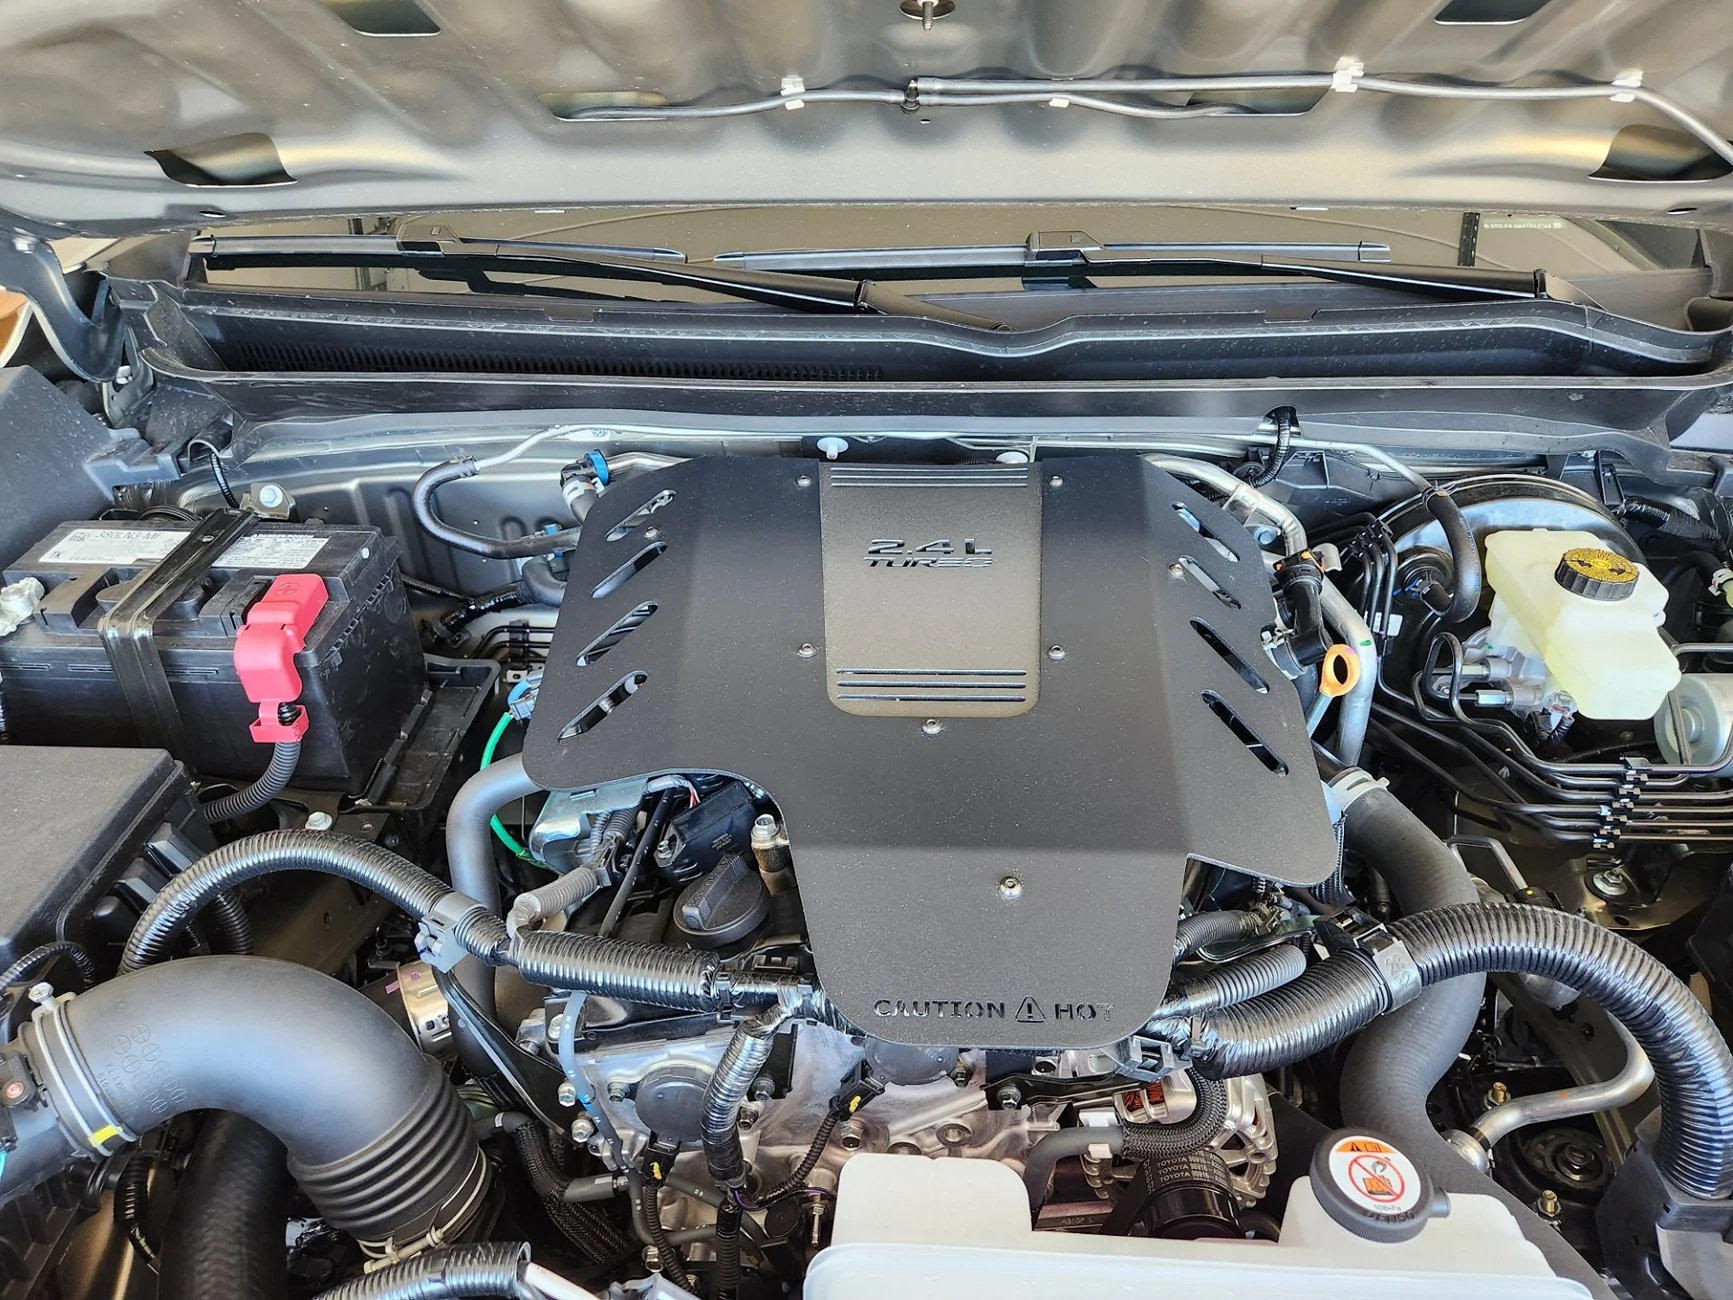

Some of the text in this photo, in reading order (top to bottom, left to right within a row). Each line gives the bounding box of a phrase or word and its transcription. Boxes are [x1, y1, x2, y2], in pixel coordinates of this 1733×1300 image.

[868, 538, 992, 555] 2.4L
[864, 556, 995, 568] TURBO
[873, 999, 1115, 1022] CAUTION HOT
[1157, 1156, 1188, 1168] TOYOTA
[1158, 1164, 1190, 1175] TOYOTA
[1160, 1171, 1191, 1182] TOYOTA
